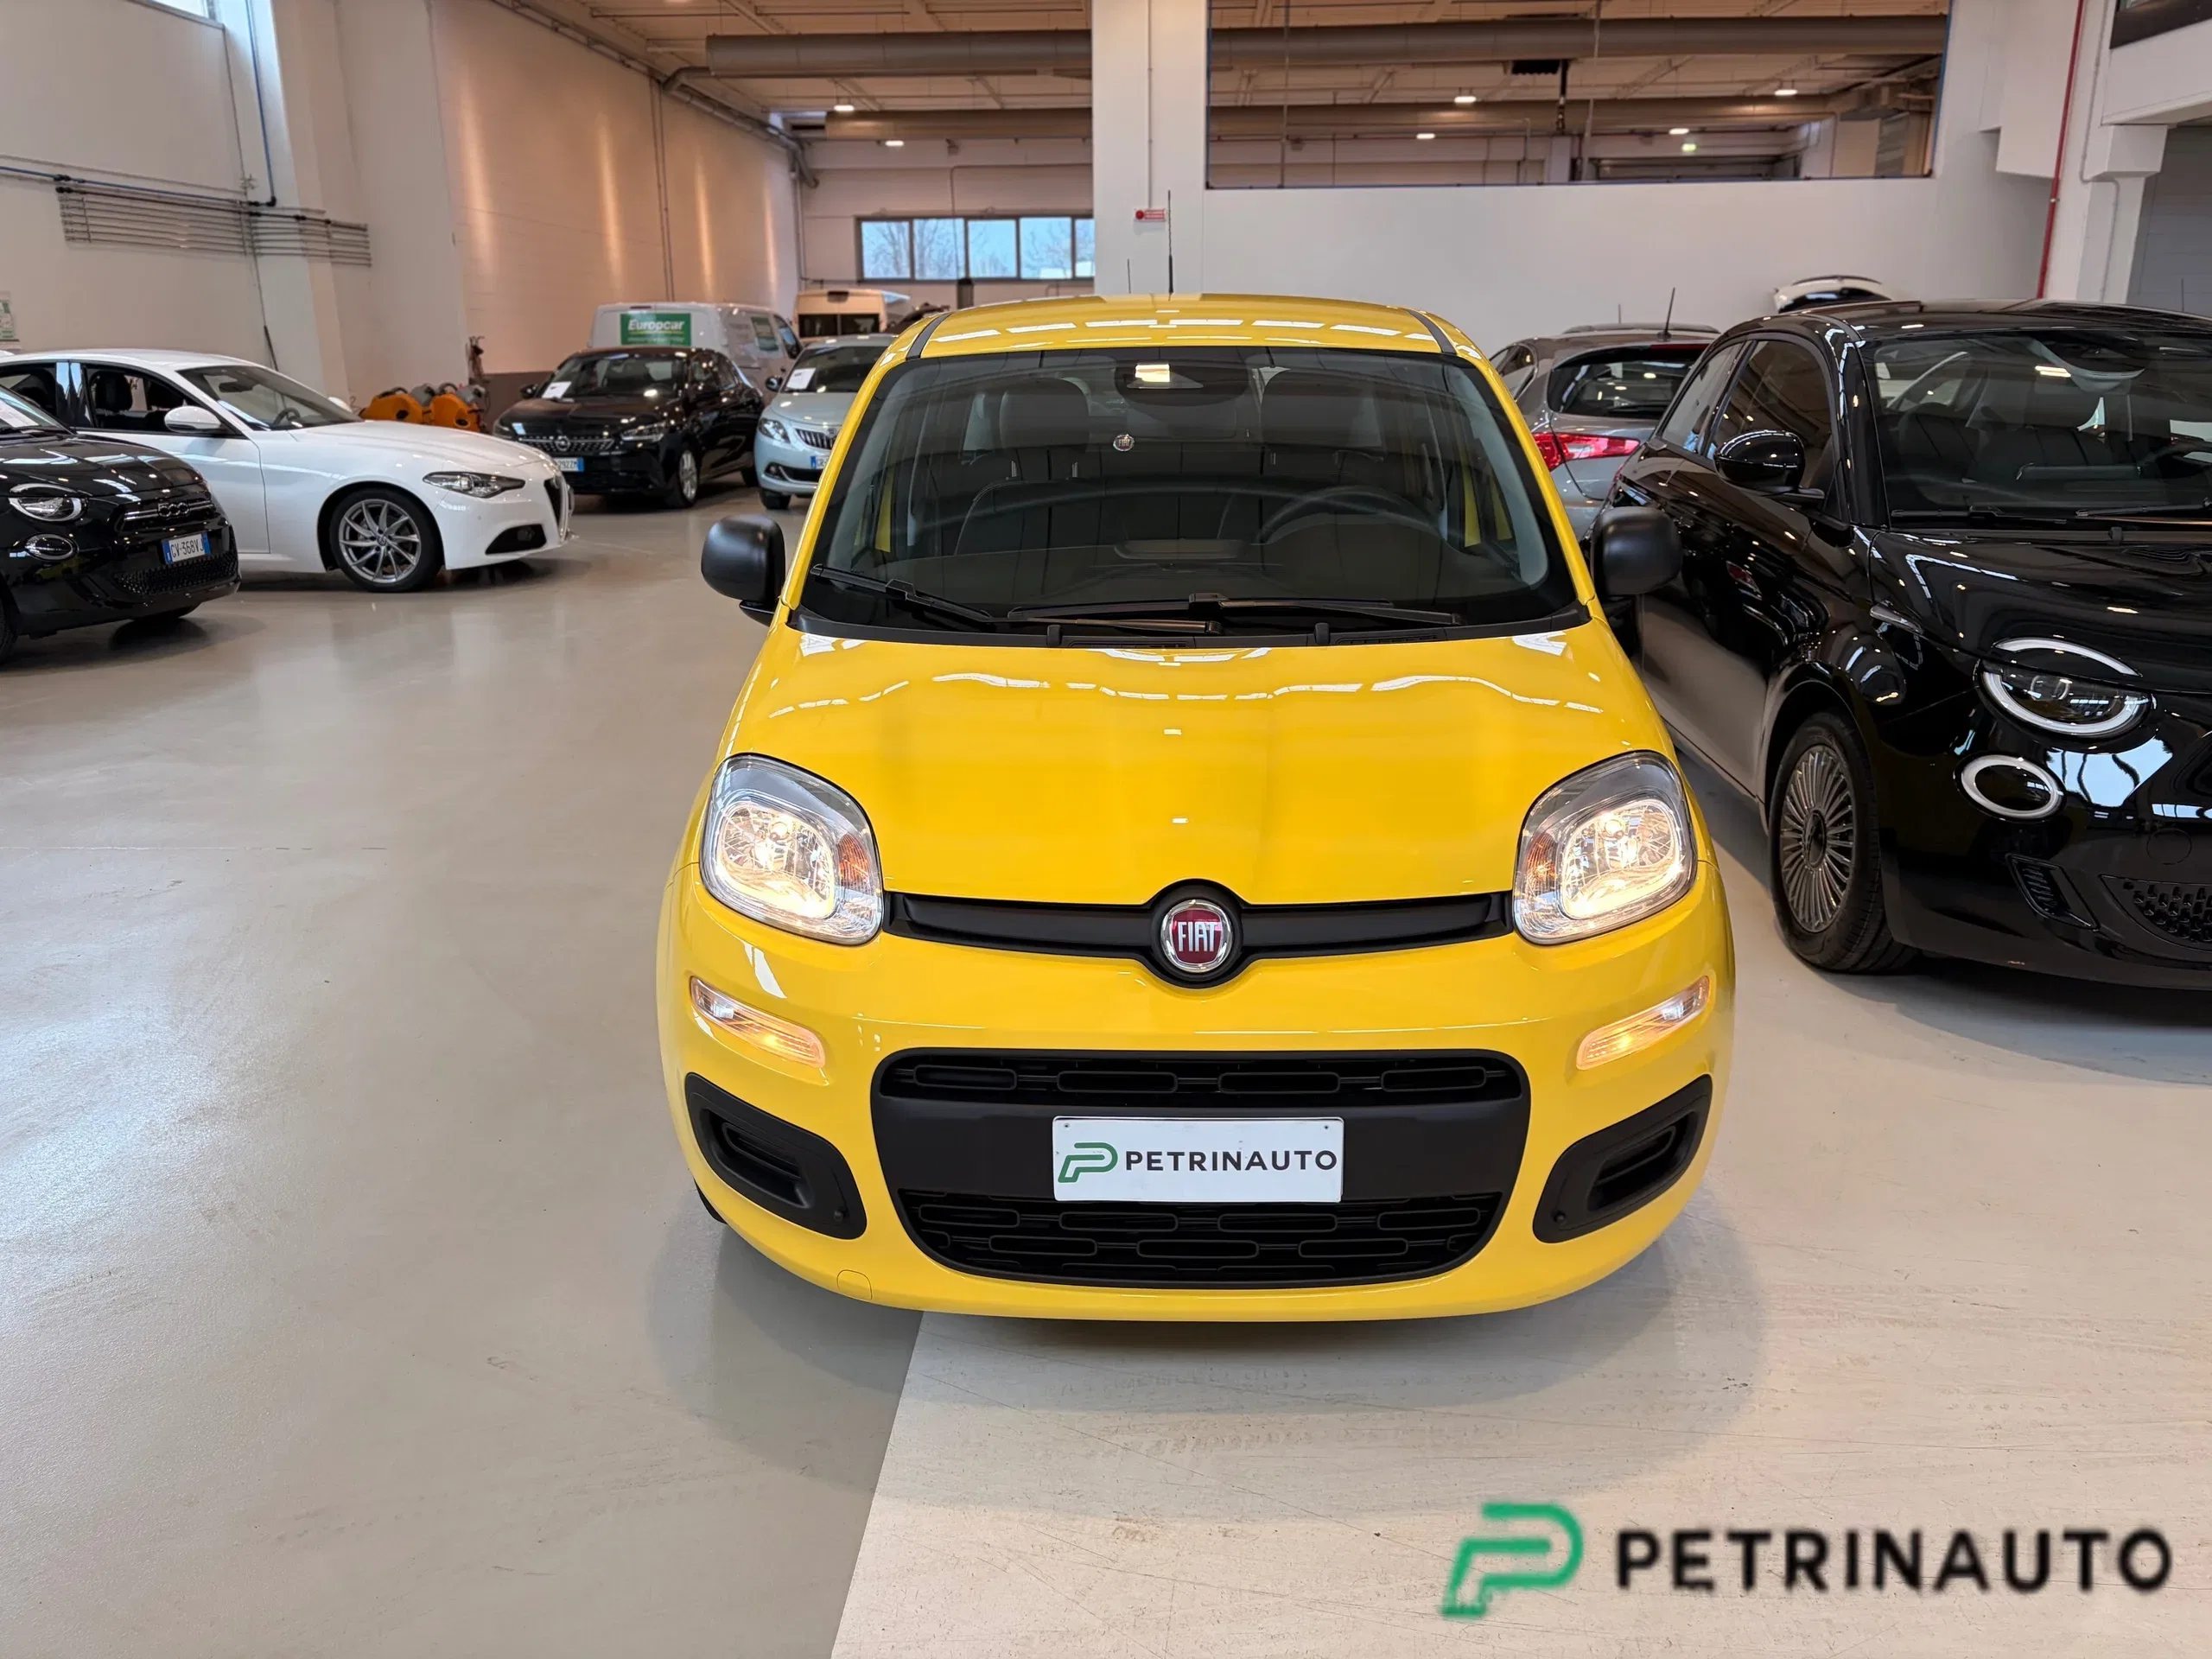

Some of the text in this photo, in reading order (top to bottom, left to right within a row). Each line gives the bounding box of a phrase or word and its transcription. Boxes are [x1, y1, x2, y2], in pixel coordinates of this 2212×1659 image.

[628, 319, 685, 331] Europcar
[1177, 921, 1219, 951] FIAT
[1126, 1150, 1337, 1172] PETRINAUTO
